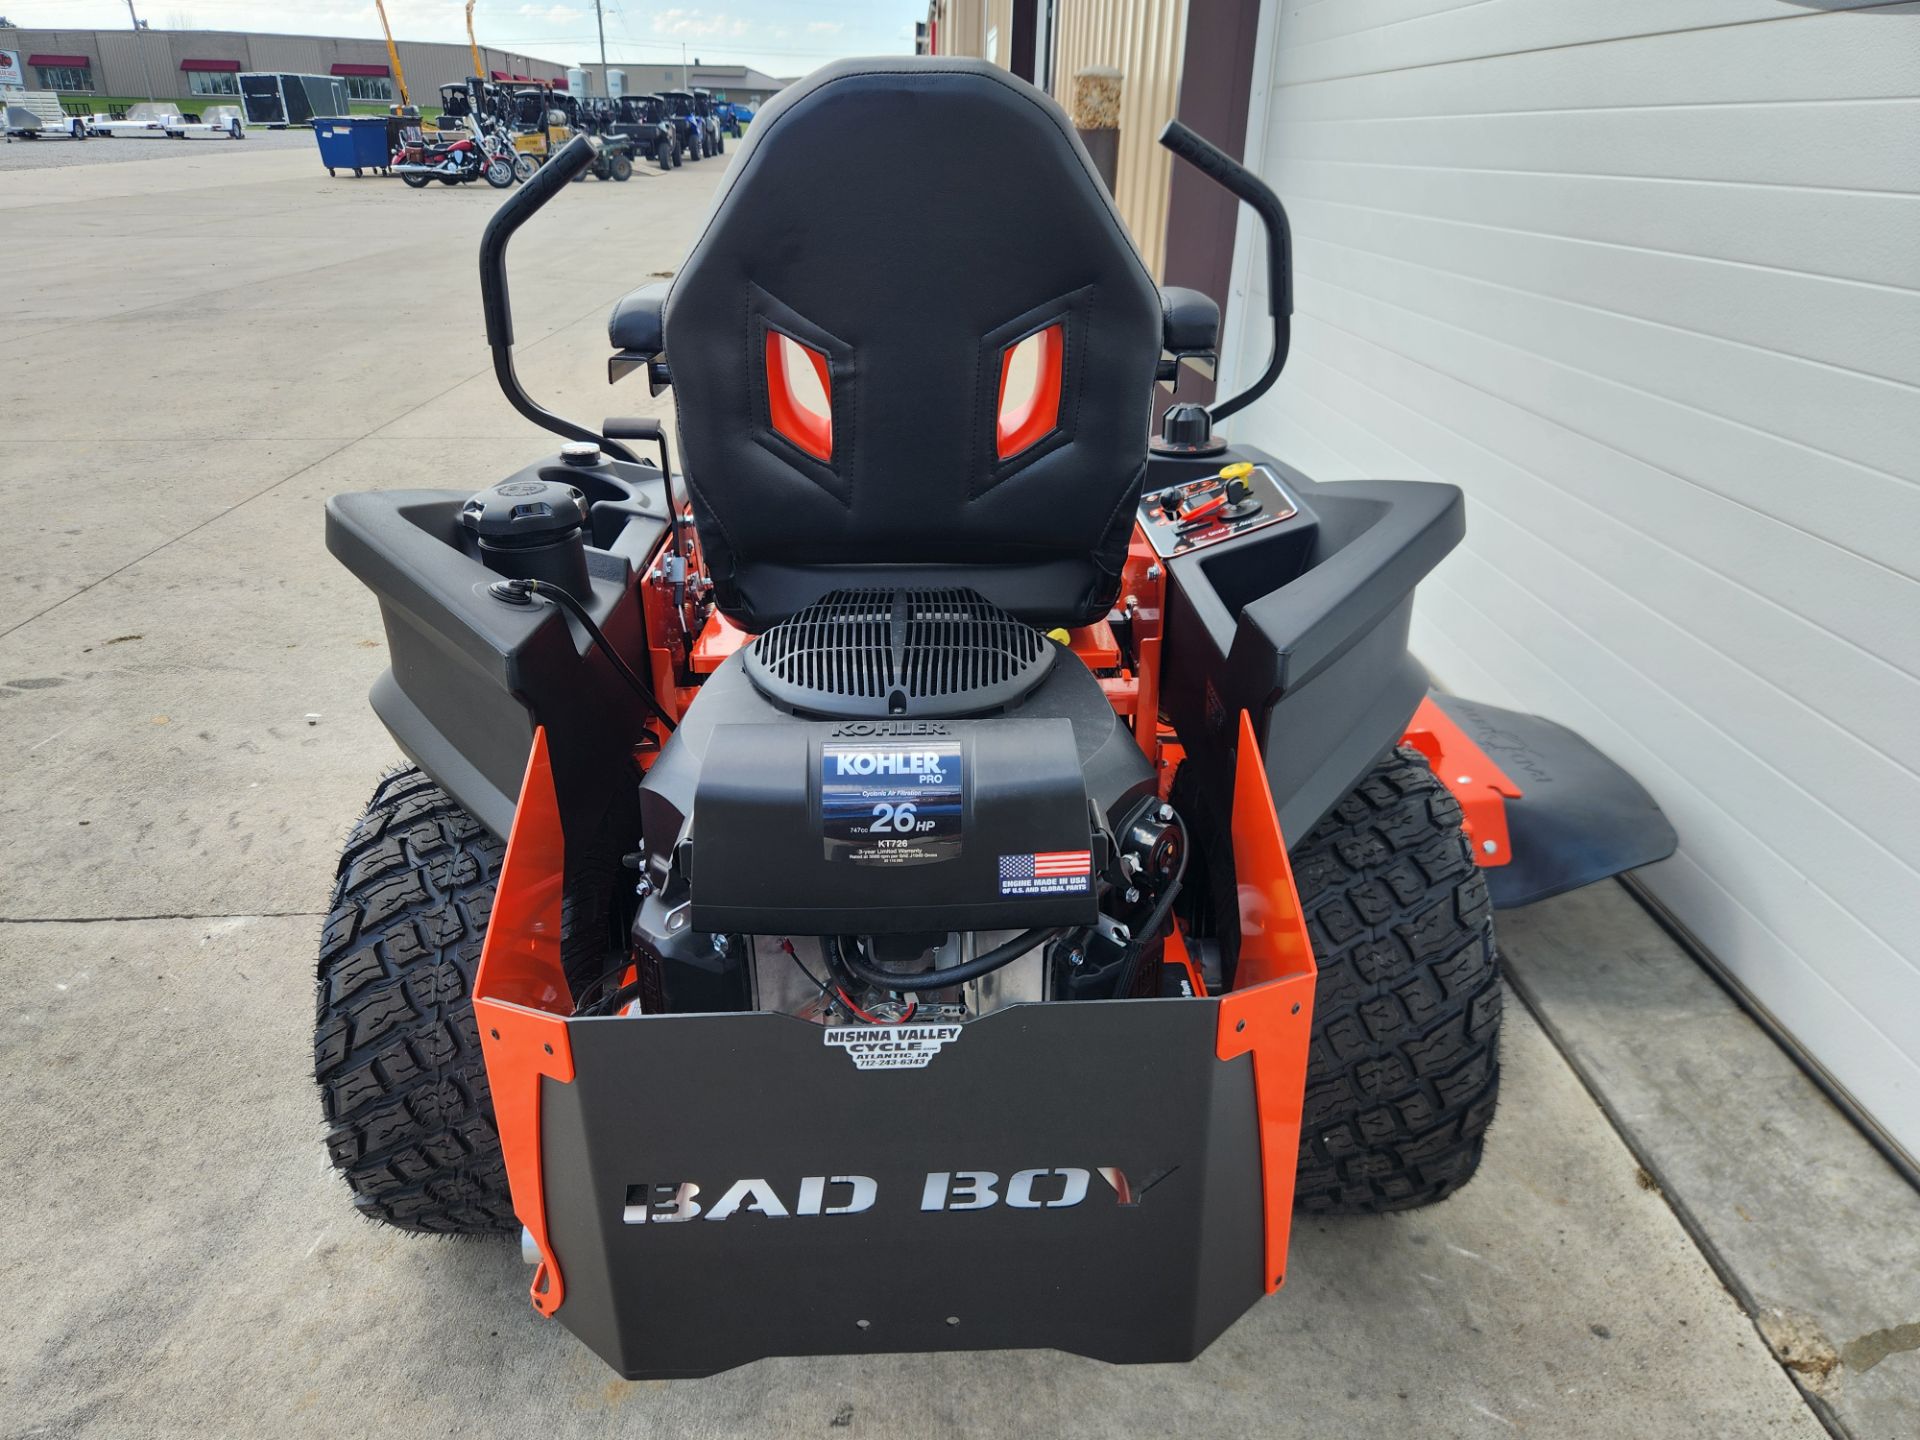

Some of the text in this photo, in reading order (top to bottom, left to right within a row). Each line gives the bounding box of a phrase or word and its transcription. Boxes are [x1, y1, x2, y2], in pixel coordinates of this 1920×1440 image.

[831, 722, 947, 737] KOHLER
[836, 752, 945, 775] KOHLER
[919, 774, 943, 784] PRO
[869, 803, 917, 833] 26
[915, 821, 936, 832] HP
[878, 840, 908, 848] KT726
[1002, 876, 1087, 888] ENGINE MADE IN USA
[1040, 884, 1065, 892] GLOBAL
[1065, 883, 1087, 891] PARTS
[827, 1027, 959, 1042] NISHNA VALLEY
[850, 1042, 922, 1052] CYCLE
[623, 1164, 1181, 1224] BAD BOY
